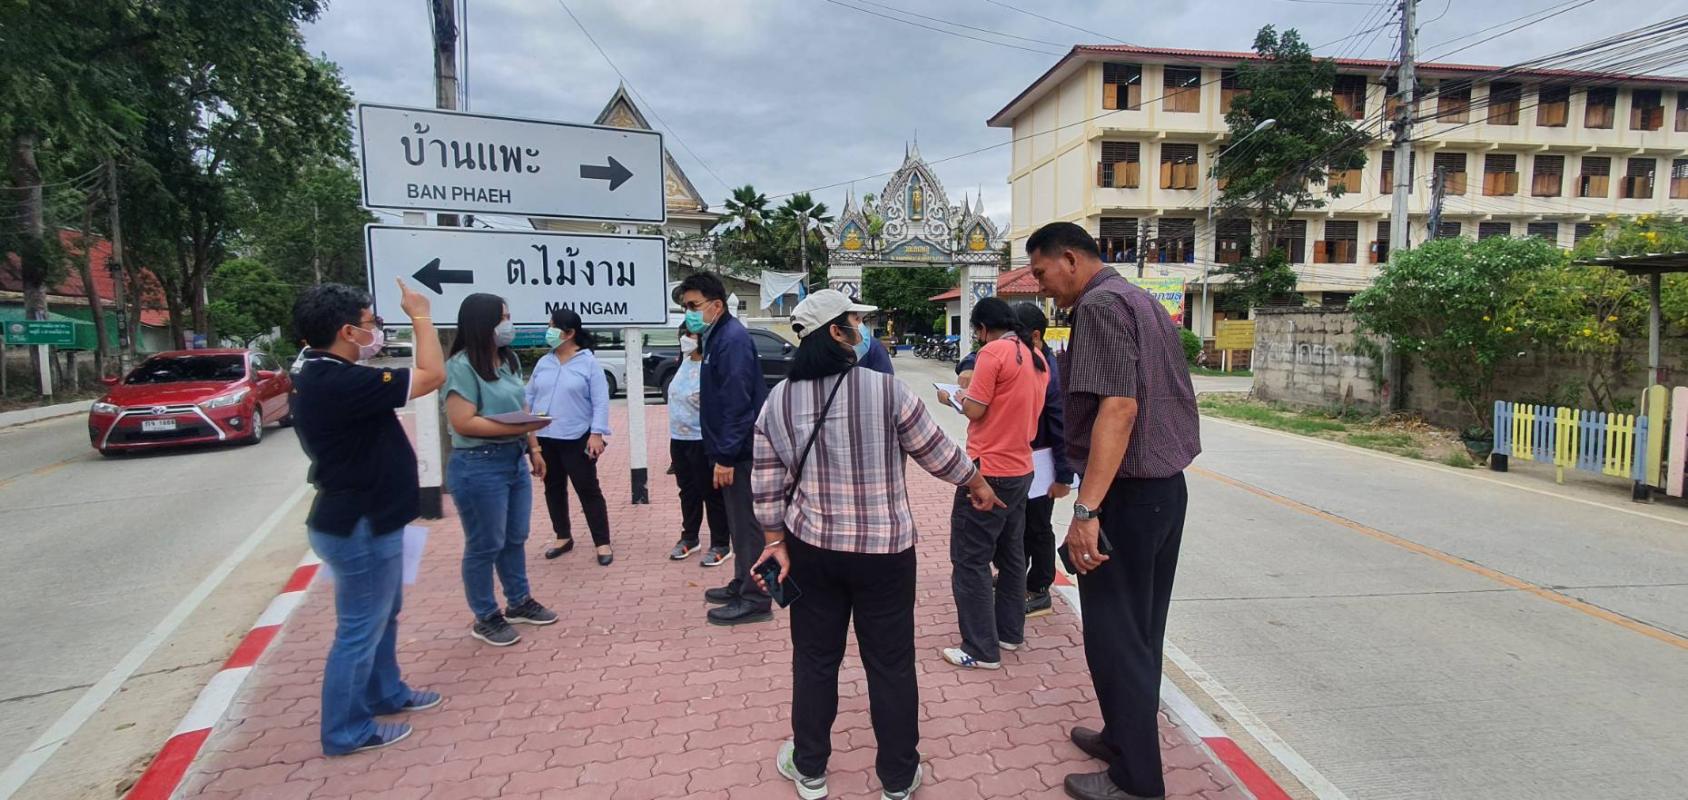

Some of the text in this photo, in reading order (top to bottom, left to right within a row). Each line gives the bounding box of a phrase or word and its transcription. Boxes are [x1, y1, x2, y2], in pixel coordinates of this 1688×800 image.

[401, 122, 540, 174] บ้านแพะ
[407, 183, 511, 204] BAN PHAEH
[507, 244, 635, 287] ต.ไม้งาม
[580, 302, 628, 315] NGAM
